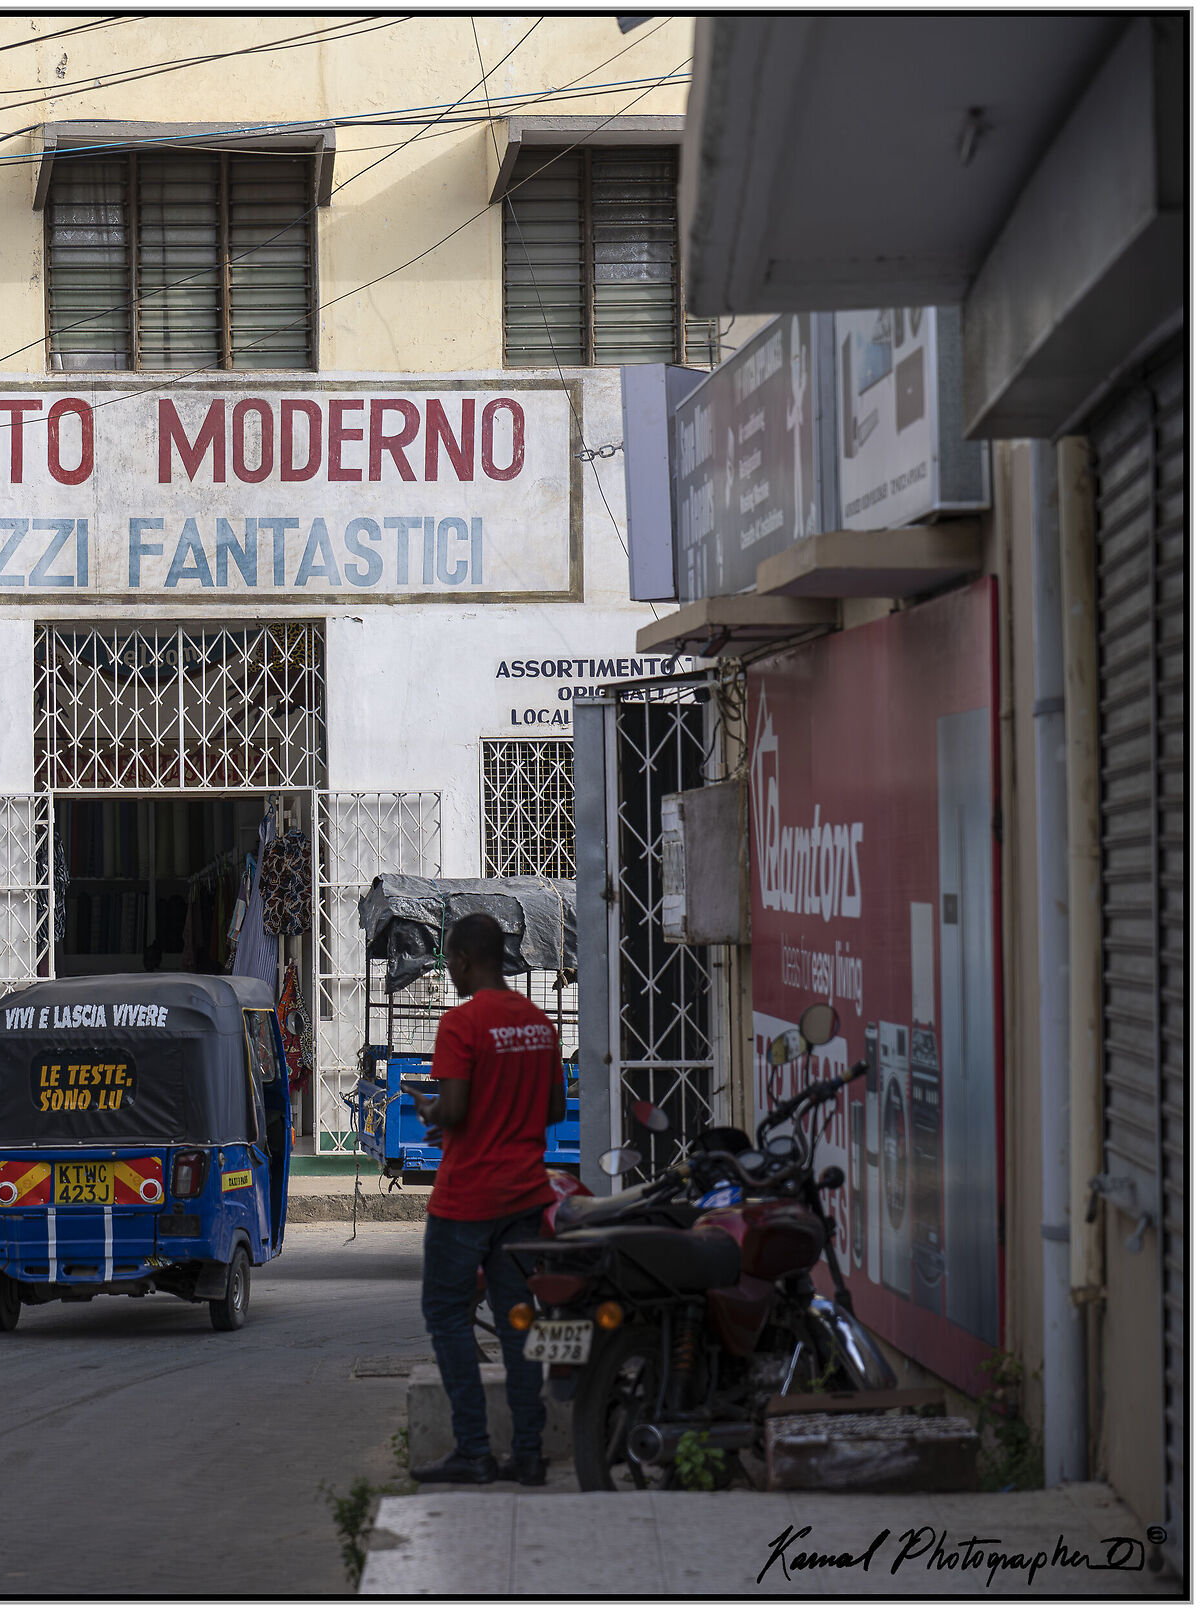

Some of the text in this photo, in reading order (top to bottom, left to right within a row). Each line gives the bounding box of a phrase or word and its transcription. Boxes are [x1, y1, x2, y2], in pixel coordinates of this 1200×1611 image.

[159, 397, 526, 484] MODERNO
[128, 516, 483, 587] FANTASTICI
[495, 657, 676, 679] ASSORTIMENTO
[812, 950, 834, 1007] easy
[836, 940, 863, 1017] living
[5, 1006, 36, 1030] VIVI
[53, 1004, 107, 1029] LASCIA
[113, 1003, 169, 1028] VIVERE
[40, 1065, 61, 1087] LE
[40, 1089, 123, 1112] SONO LU
[59, 1164, 107, 1184] KTWC
[59, 1184, 109, 1203] 423J
